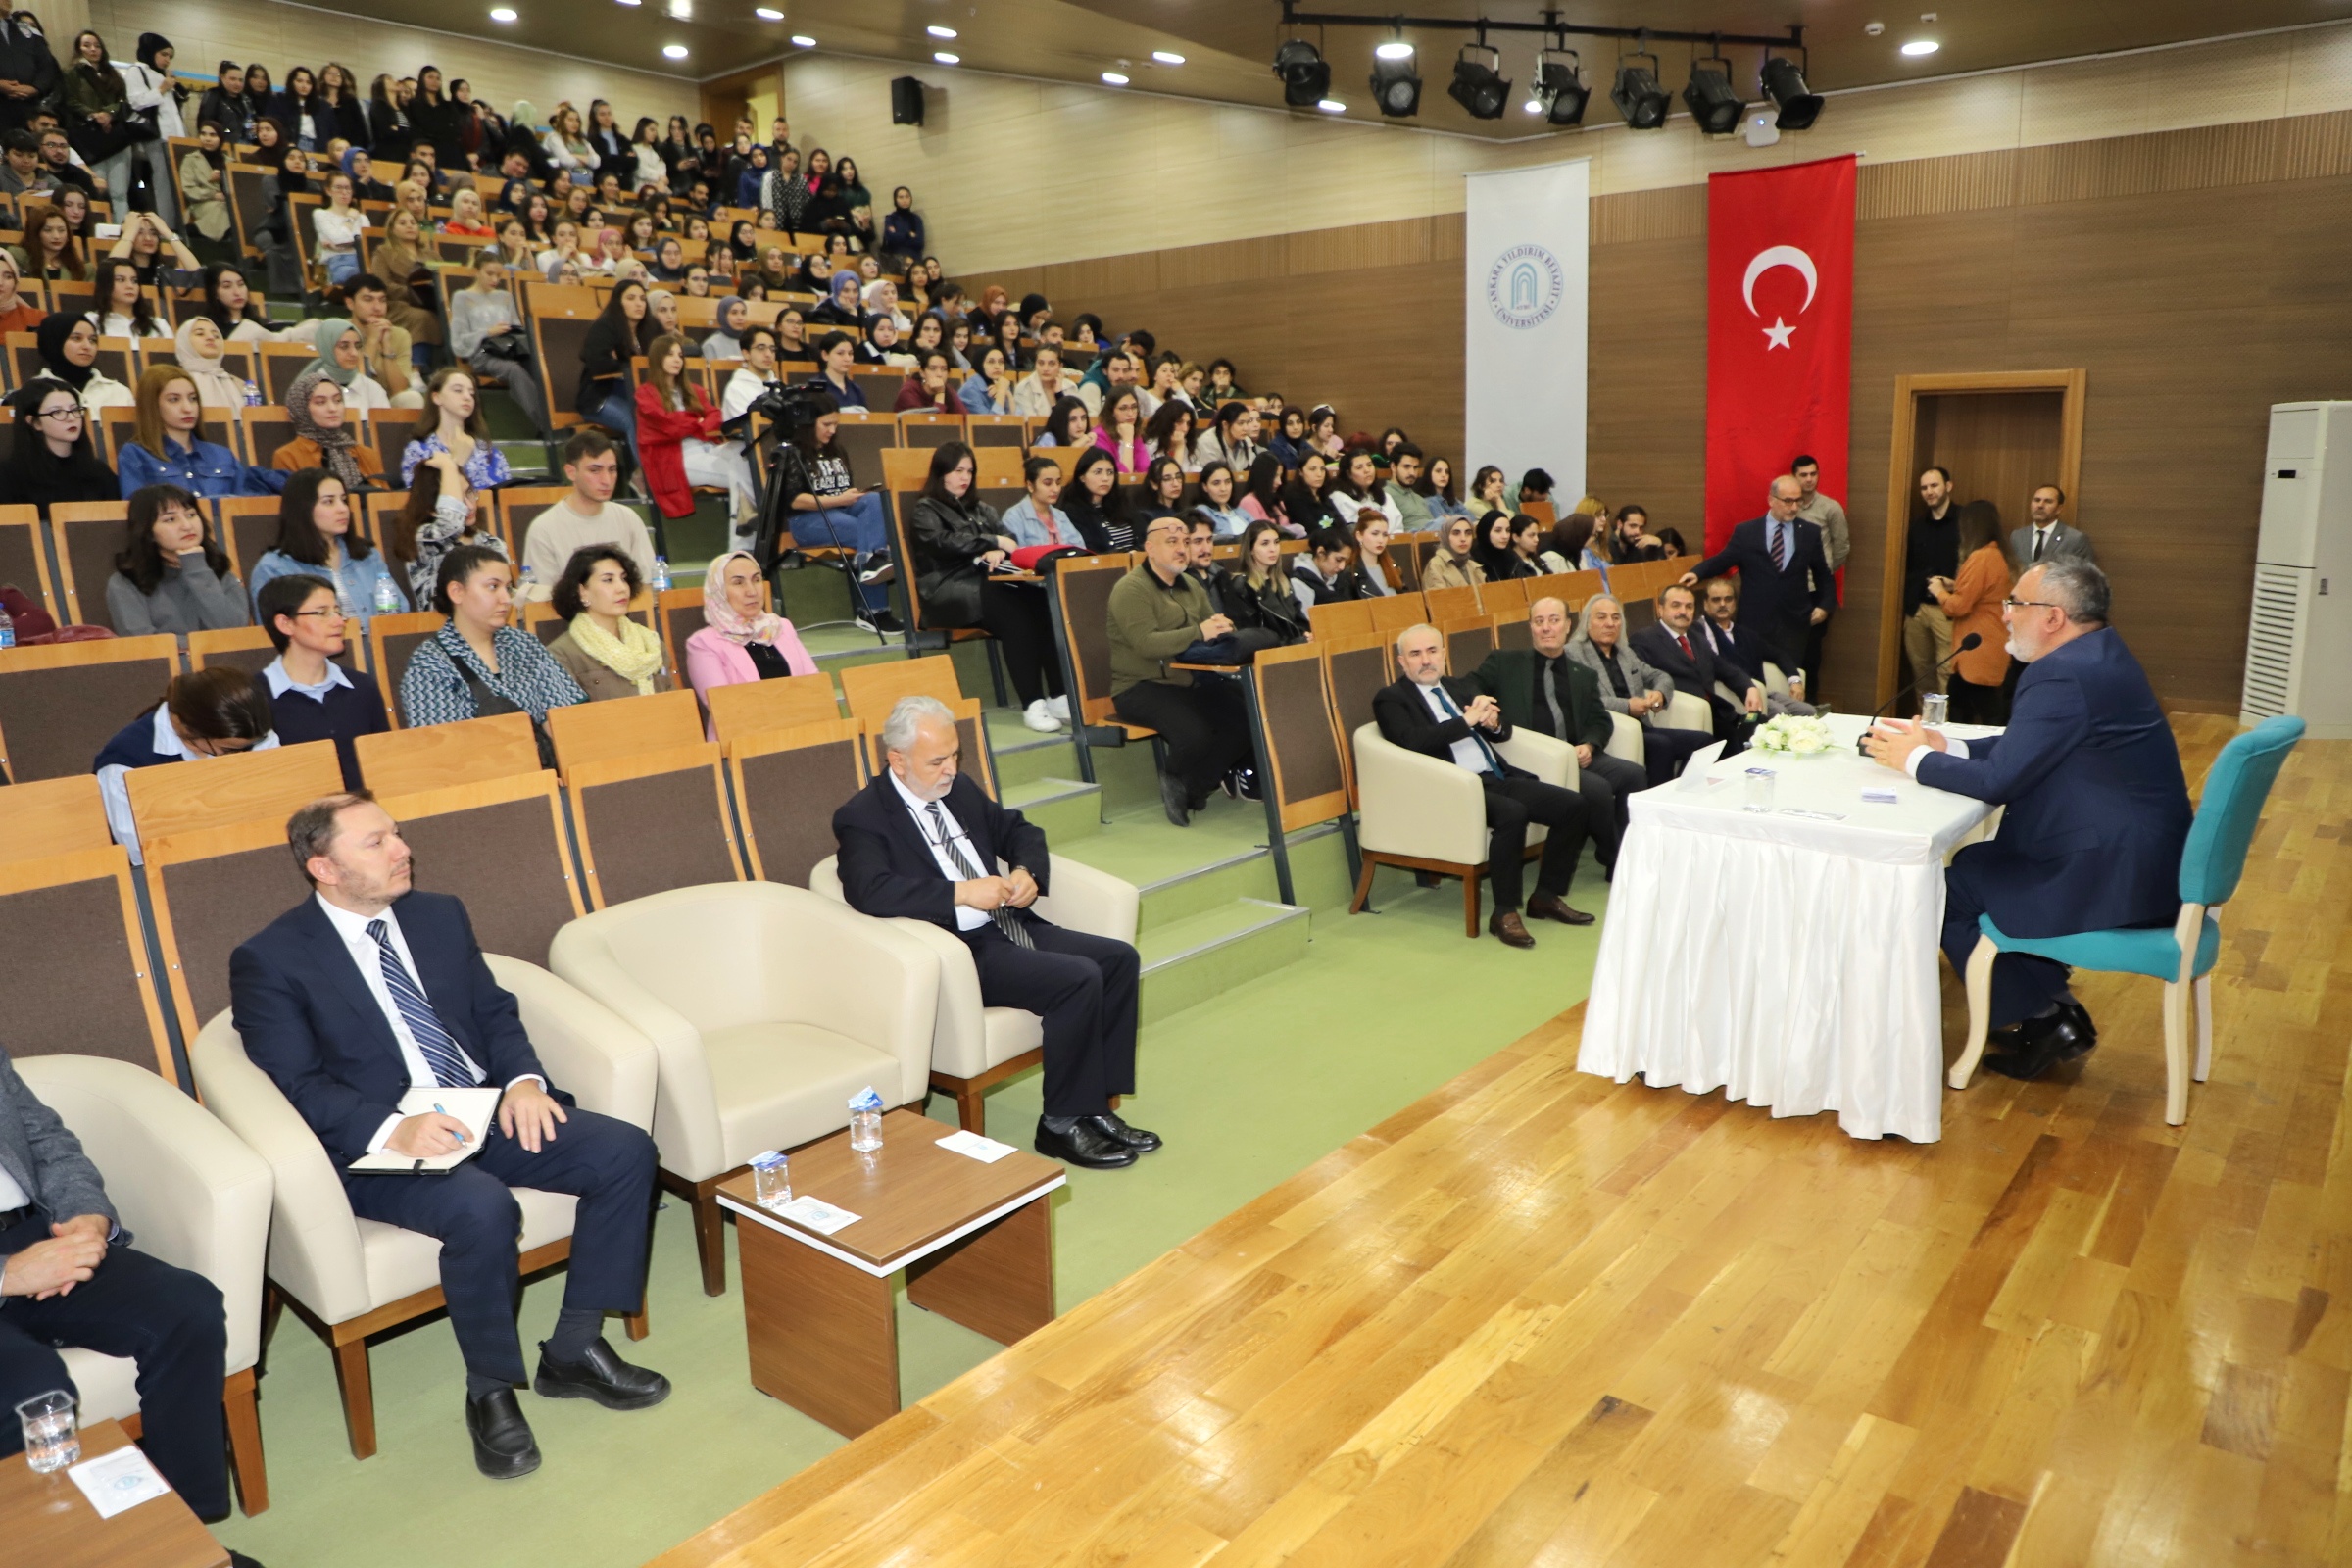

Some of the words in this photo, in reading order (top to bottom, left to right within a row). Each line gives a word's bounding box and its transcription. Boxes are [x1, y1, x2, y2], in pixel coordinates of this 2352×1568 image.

[1490, 264, 1503, 302] ANKARA
[1501, 247, 1545, 264] YILDIRIM
[1544, 257, 1561, 297] BEYAZIT
